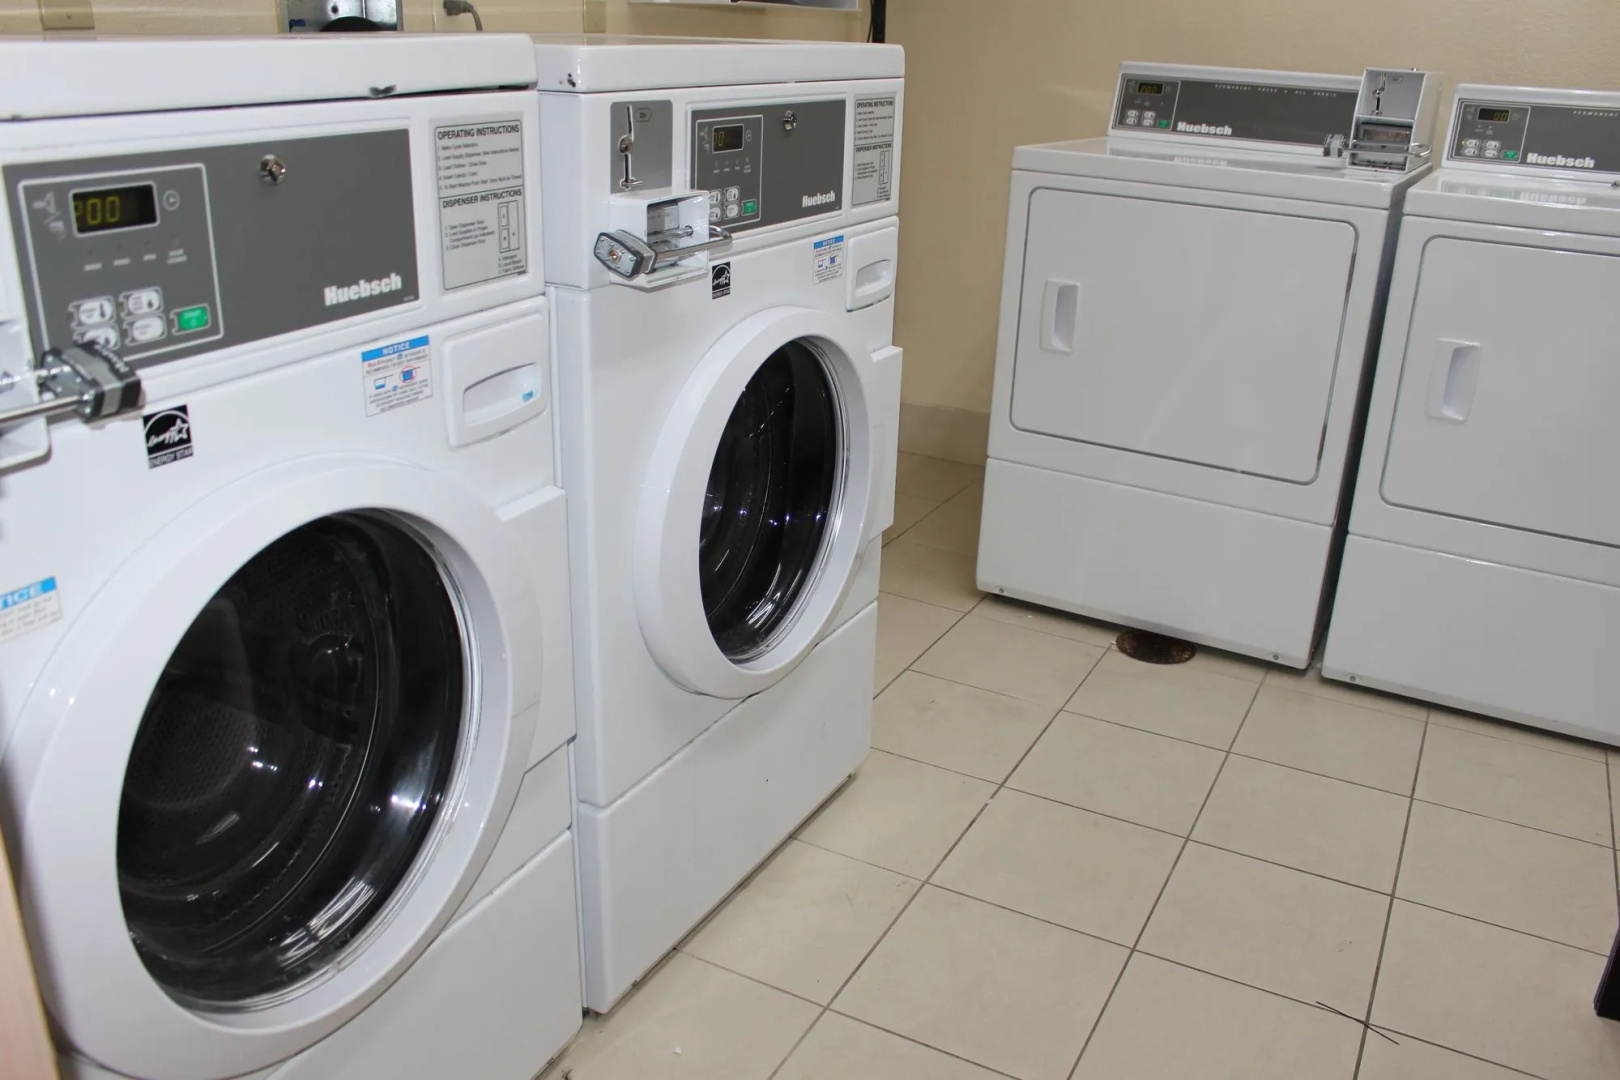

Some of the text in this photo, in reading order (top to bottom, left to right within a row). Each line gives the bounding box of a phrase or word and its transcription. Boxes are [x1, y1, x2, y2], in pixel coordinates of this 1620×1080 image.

[438, 124, 519, 140] OPERATING INSTRUCTIONS
[1177, 121, 1232, 136] Huebsch
[1526, 152, 1595, 168] Huebsch
[442, 188, 522, 208] DISPENSER INSTRUCTIONS
[802, 190, 835, 208] Huebsch
[324, 272, 402, 306] Huebsch
[382, 342, 410, 354] NOTICE
[149, 446, 193, 469] ENERGY STAR
